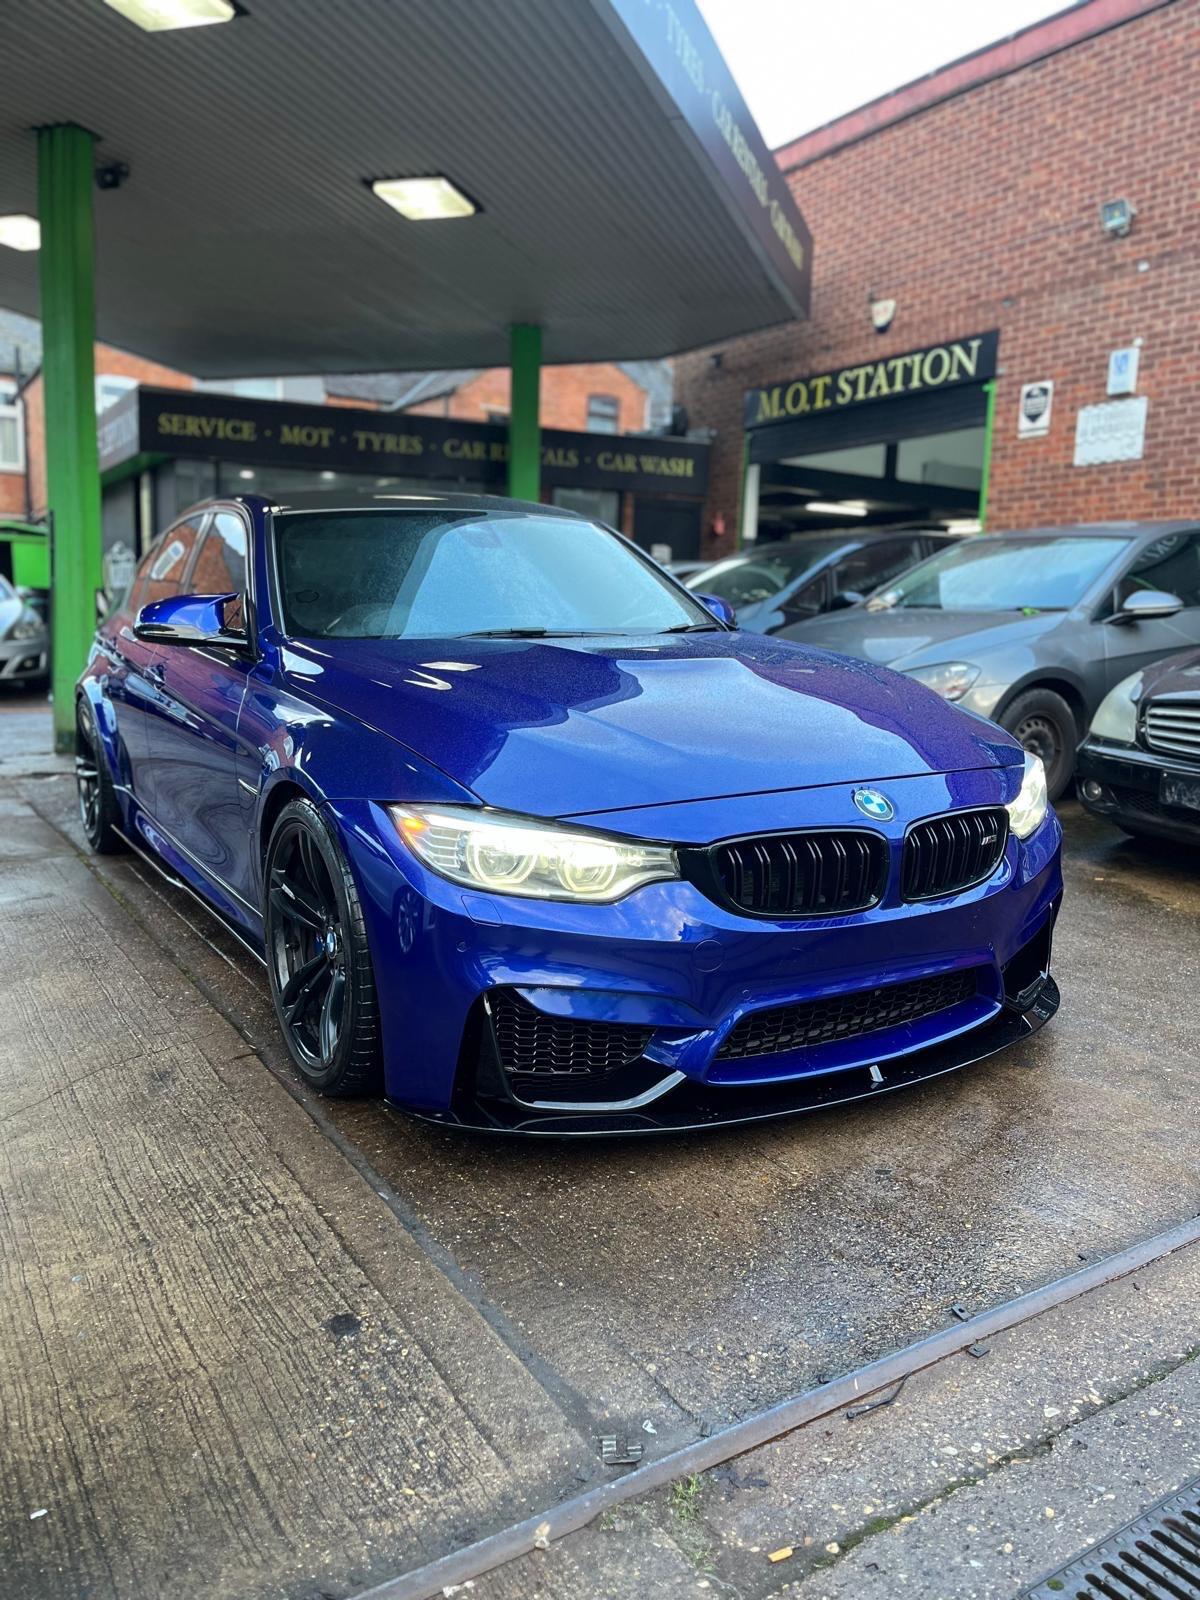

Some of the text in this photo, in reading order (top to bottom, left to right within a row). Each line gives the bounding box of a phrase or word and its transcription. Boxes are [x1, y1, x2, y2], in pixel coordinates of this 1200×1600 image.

[835, 339, 983, 405] STATION
[157, 413, 257, 442] SERVICE
[279, 425, 334, 448] MOT
[353, 430, 424, 456] TYRES
[443, 438, 486, 461] CAR
[596, 451, 637, 473] CAR
[638, 455, 695, 478] WASH
